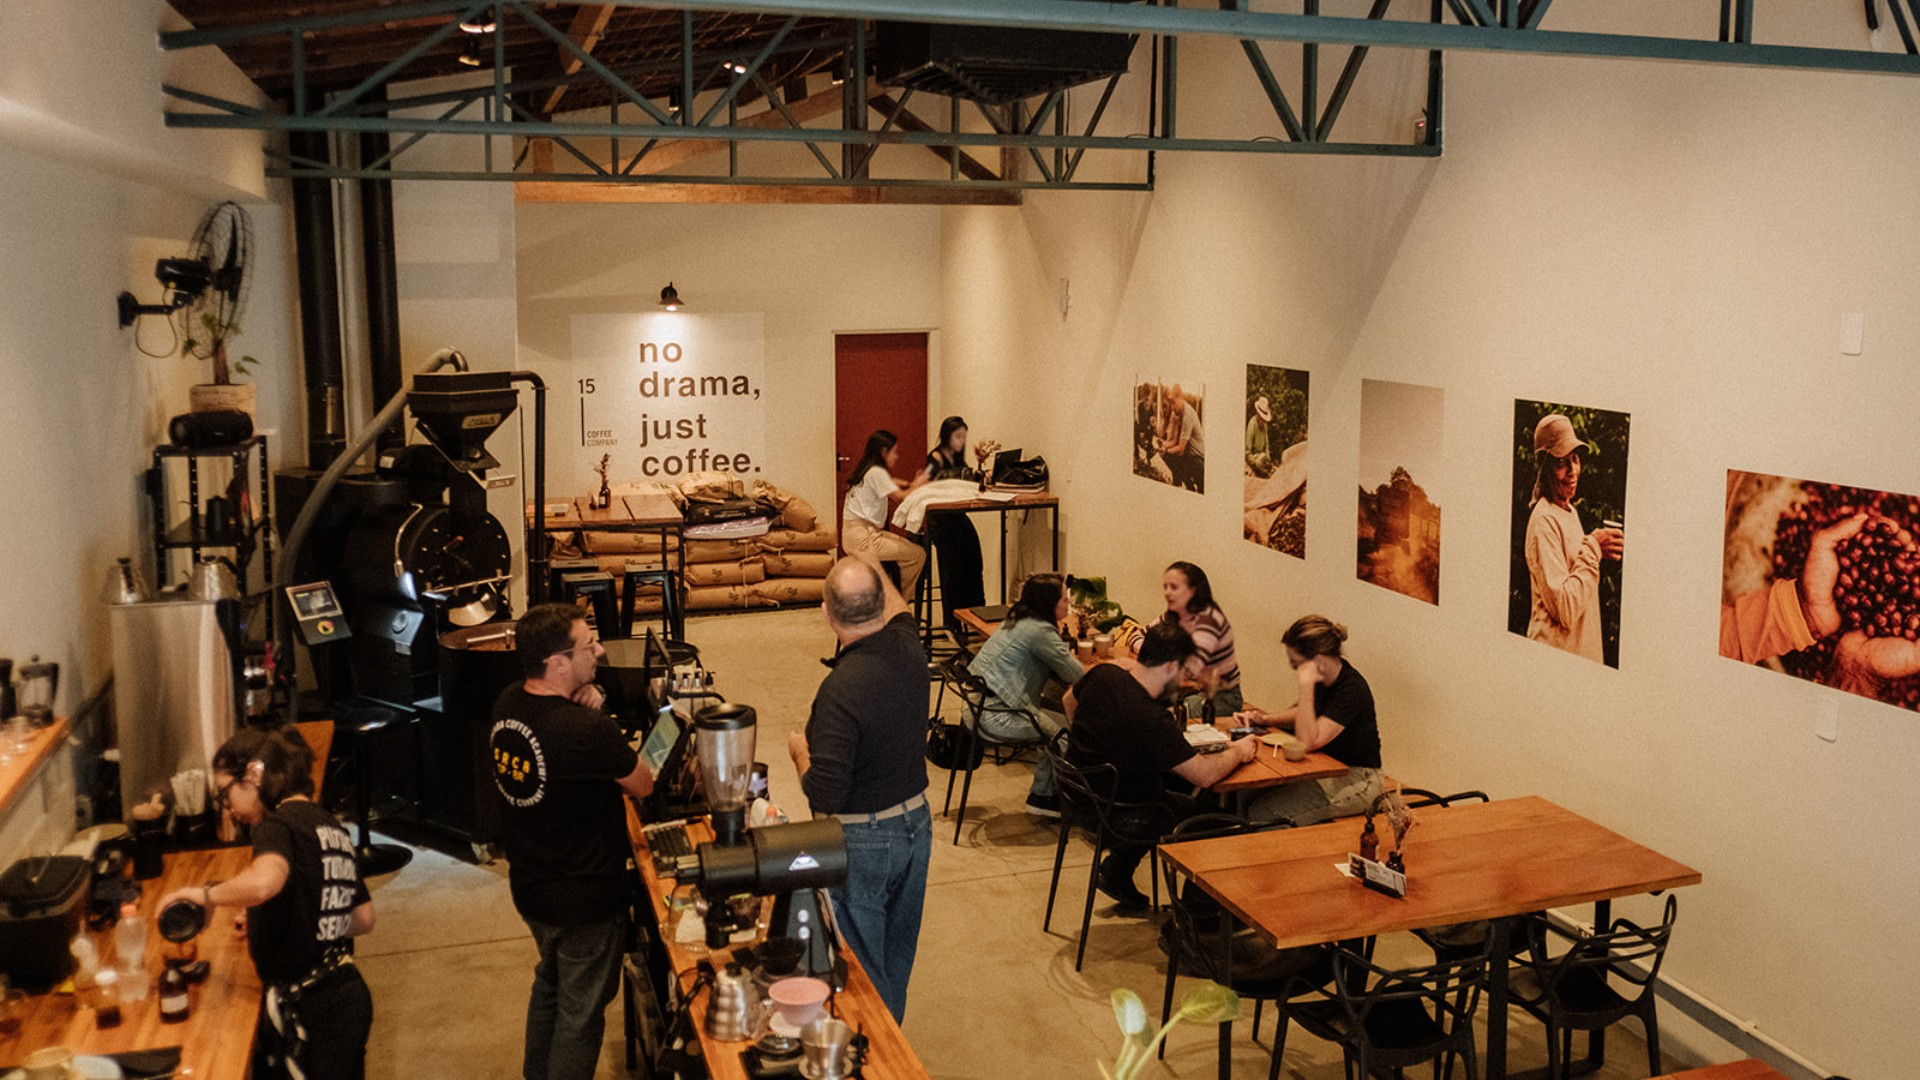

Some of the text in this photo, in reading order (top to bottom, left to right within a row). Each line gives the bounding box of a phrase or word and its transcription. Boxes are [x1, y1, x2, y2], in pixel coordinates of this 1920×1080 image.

[639, 342, 683, 363] no
[577, 378, 596, 395] 15
[639, 371, 761, 400] drama,
[586, 430, 613, 439] COFFEE
[586, 439, 619, 447] COMPANY
[639, 413, 707, 448] just
[641, 448, 761, 477] coffee.
[505, 719, 547, 781] COFFEE ACADEMY
